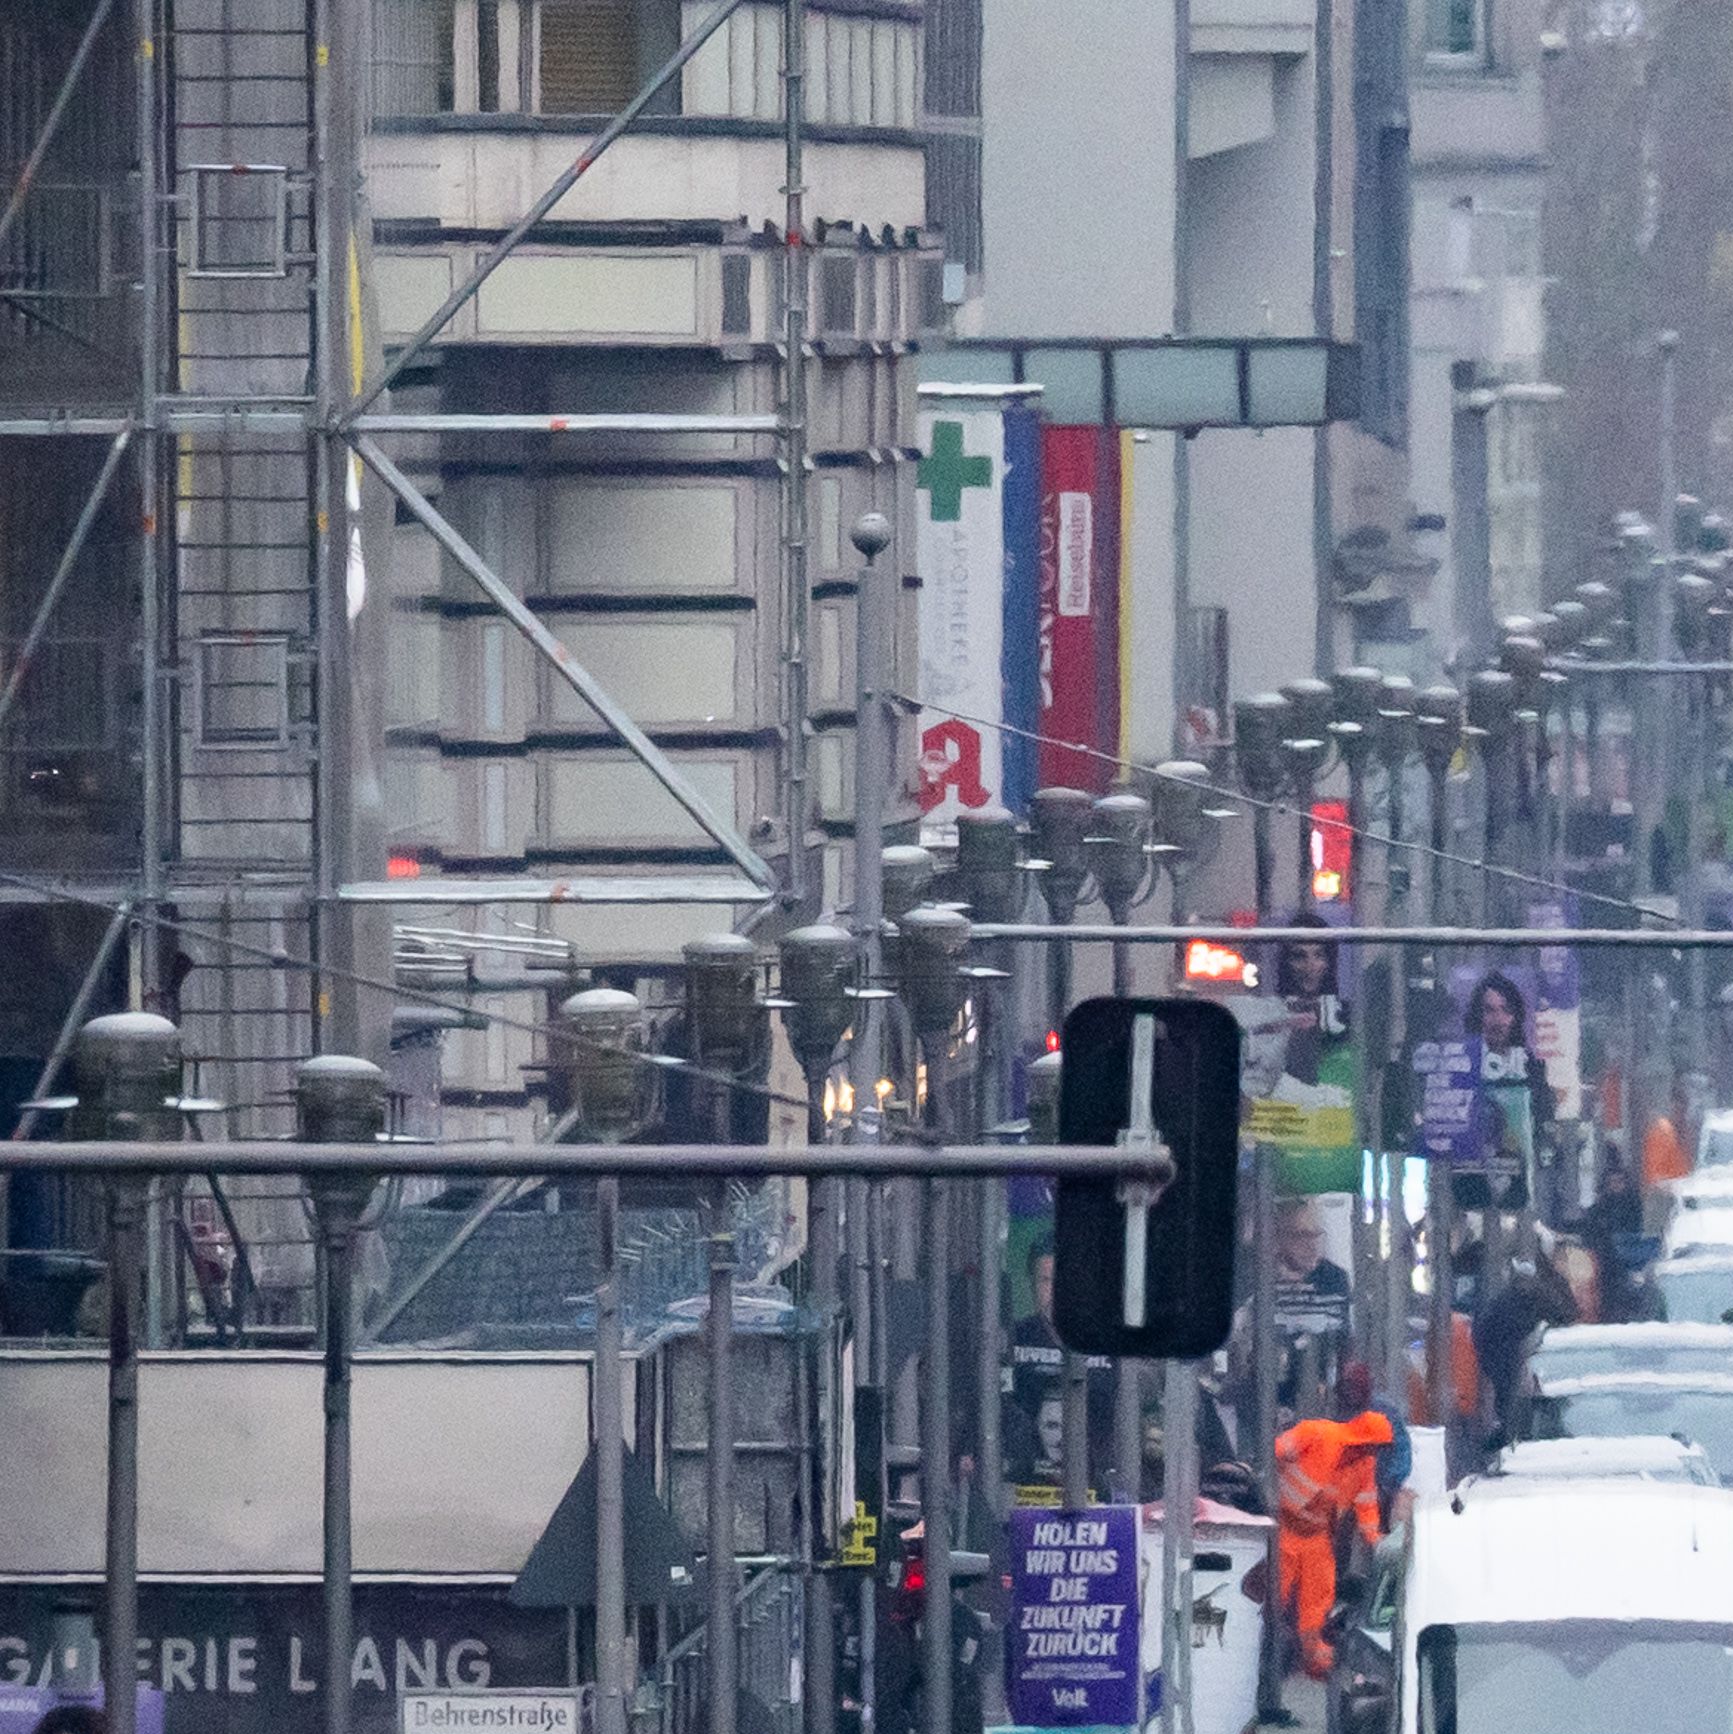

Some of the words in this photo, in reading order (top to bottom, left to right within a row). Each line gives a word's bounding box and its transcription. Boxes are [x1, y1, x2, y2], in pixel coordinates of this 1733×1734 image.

[1032, 1521, 1108, 1547] HOLEN
[1026, 1549, 1066, 1574] WIR
[1070, 1549, 1119, 1574] UNS
[1051, 1576, 1089, 1602] DIE
[1020, 1603, 1127, 1630] ZUKUNFT
[1025, 1630, 1120, 1656] ZURÜCK
[289, 1636, 493, 1692] LANG
[414, 1700, 569, 1732] Behrenstraße
